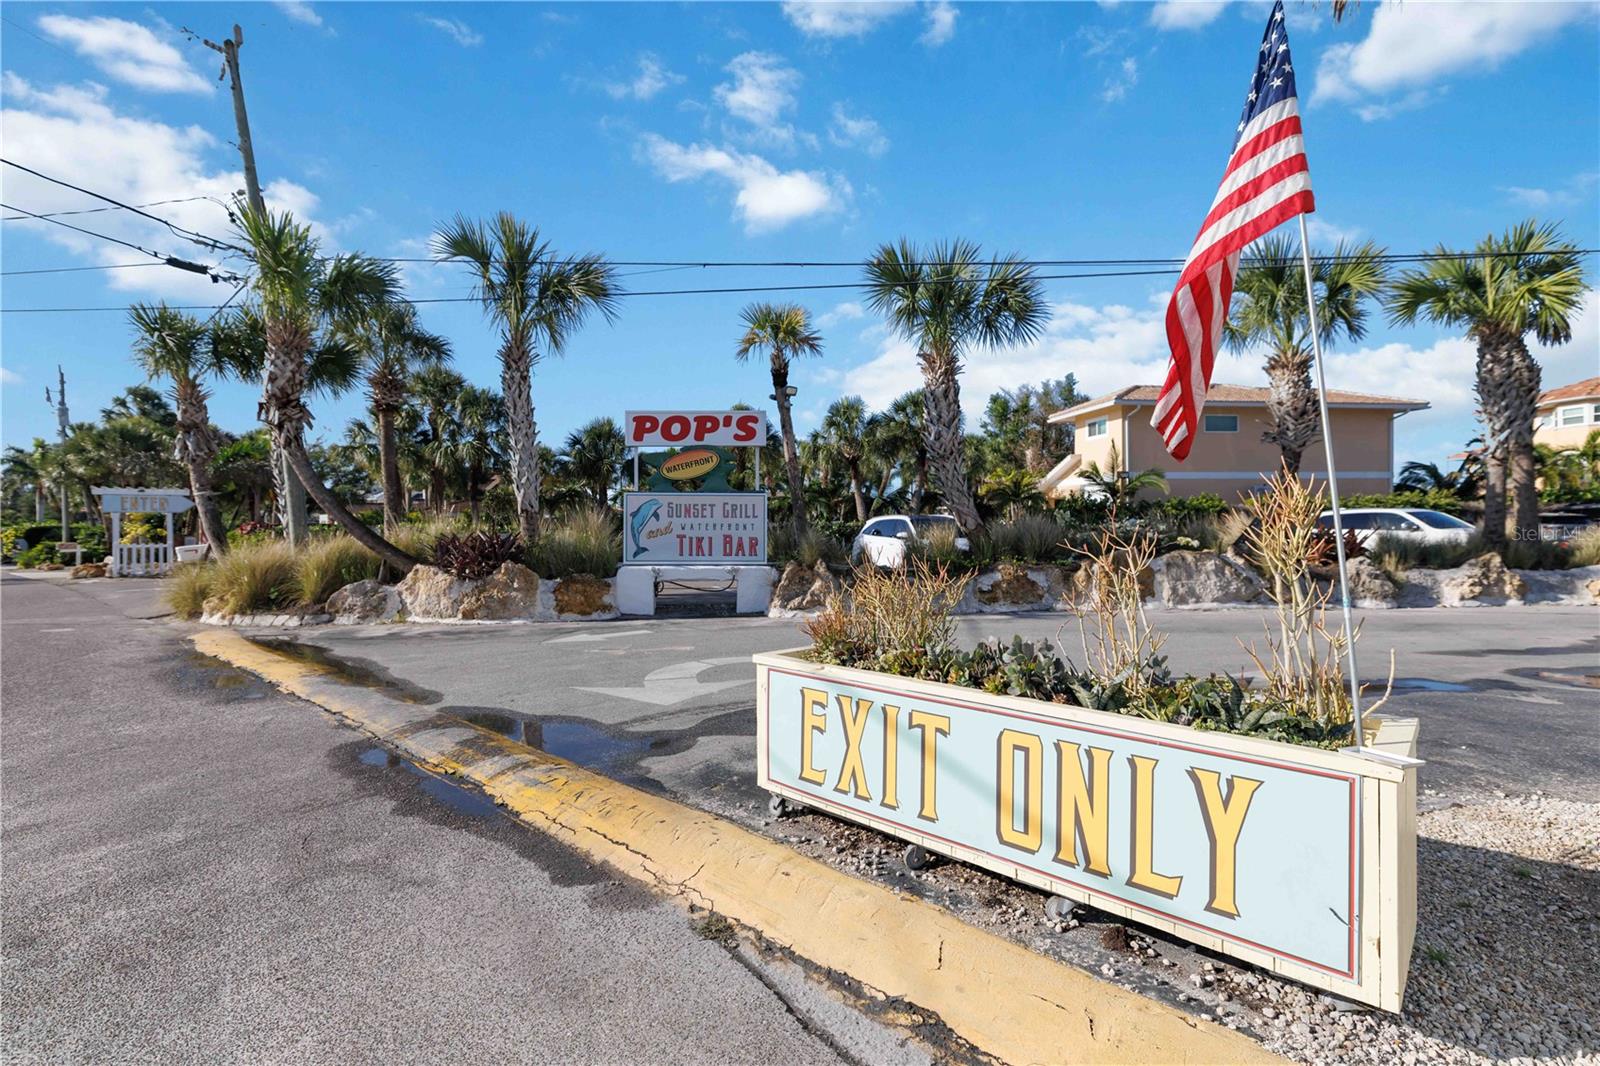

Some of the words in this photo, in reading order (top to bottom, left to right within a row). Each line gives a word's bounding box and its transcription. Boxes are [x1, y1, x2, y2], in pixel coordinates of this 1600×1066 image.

[632, 415, 759, 442] POP'S
[665, 455, 714, 474] WATERFRONT
[121, 496, 168, 511] ENTER
[667, 502, 716, 519] SUNSET
[722, 502, 758, 519] GRILL
[646, 521, 673, 540] and
[680, 523, 755, 531] WATERFRONT
[676, 534, 713, 557] TIKI
[722, 534, 759, 557] BAR
[799, 687, 951, 822] EXIT
[998, 728, 1265, 919] ONLY
